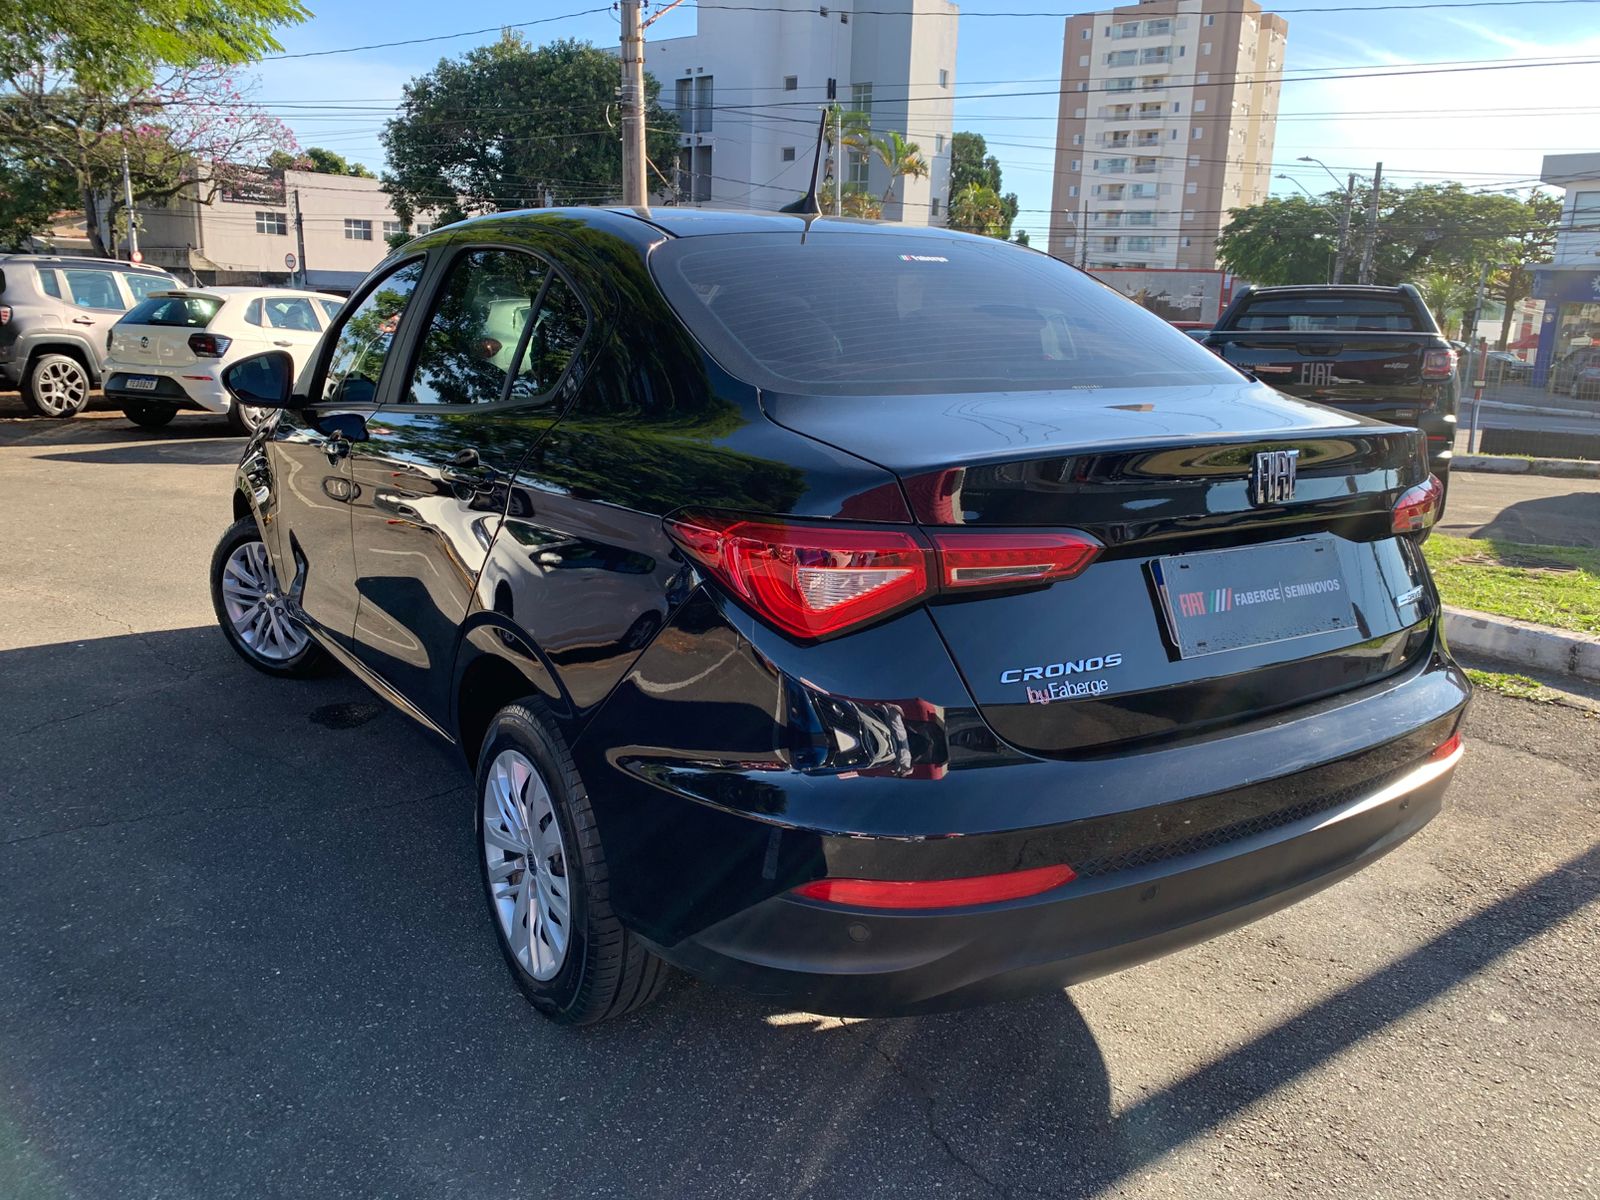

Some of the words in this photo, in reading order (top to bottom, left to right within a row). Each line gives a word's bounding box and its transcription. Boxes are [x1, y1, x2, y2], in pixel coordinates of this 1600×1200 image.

[1300, 362, 1335, 387] FIAT
[1256, 449, 1300, 504] FIAT
[1178, 591, 1207, 618] FIAT
[1234, 587, 1281, 607] FABERGE
[1284, 578, 1342, 599] SEMINOVOS
[1000, 652, 1123, 684] CRONOS
